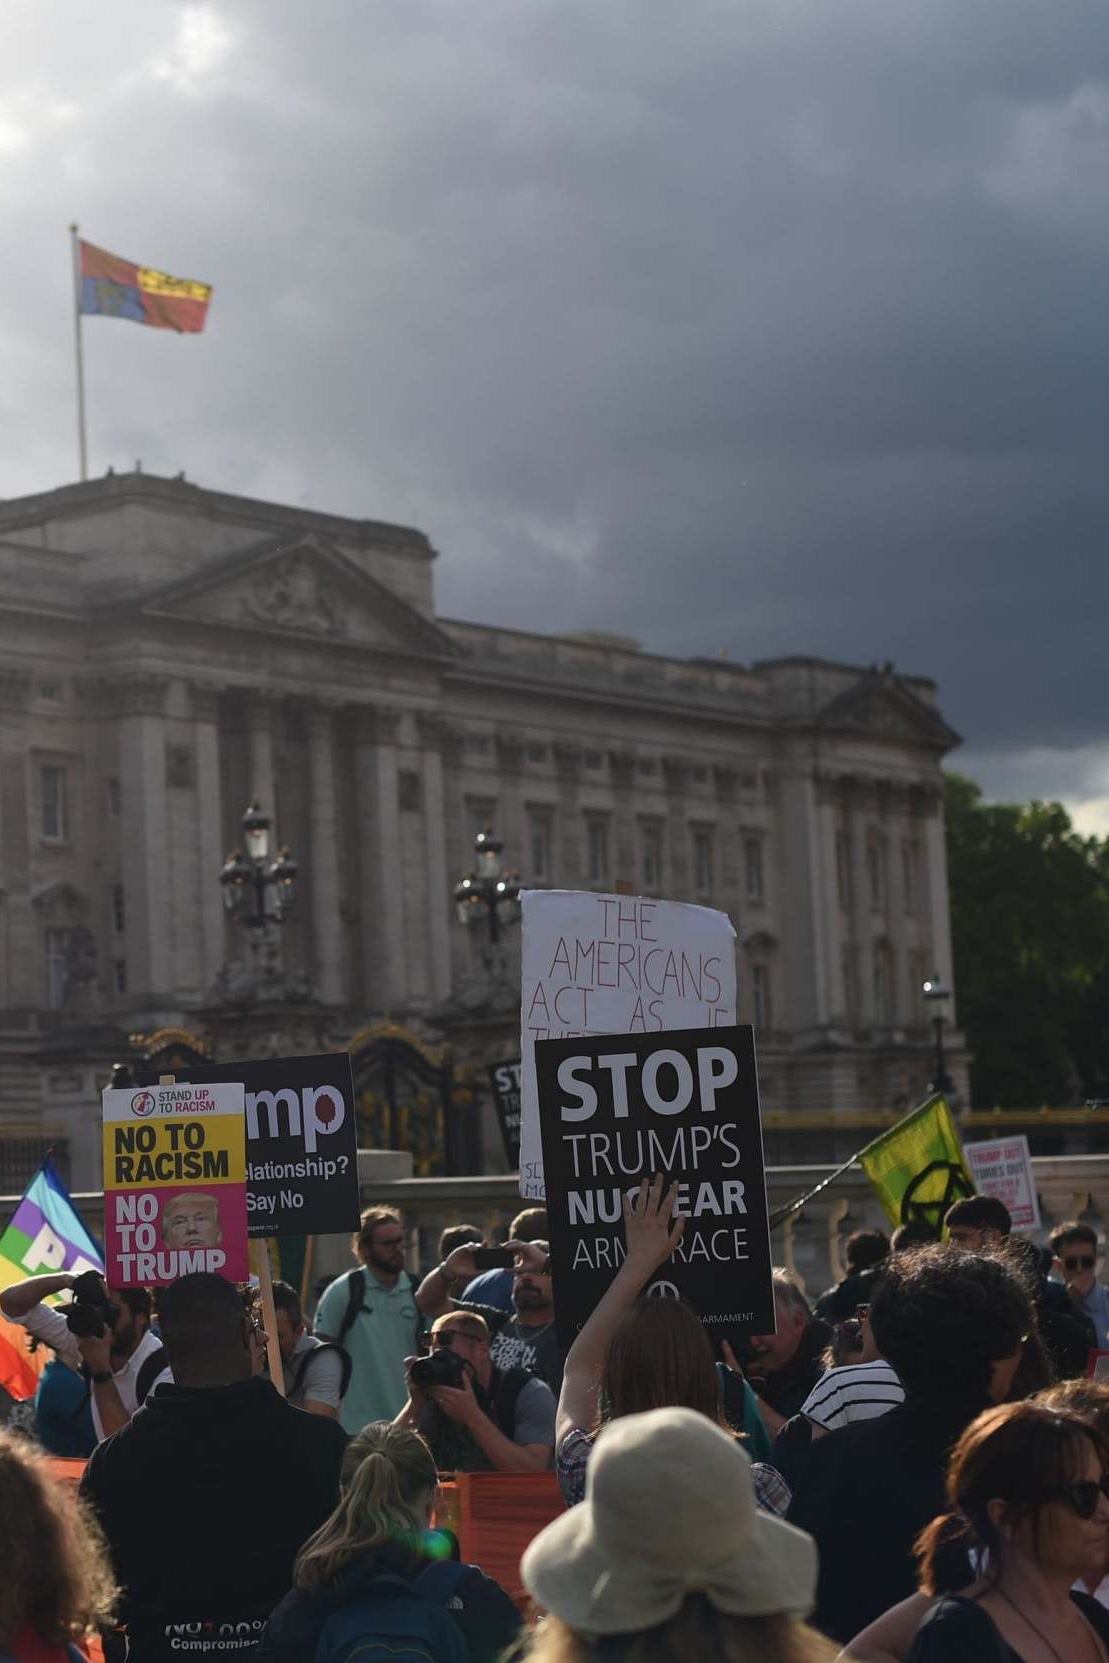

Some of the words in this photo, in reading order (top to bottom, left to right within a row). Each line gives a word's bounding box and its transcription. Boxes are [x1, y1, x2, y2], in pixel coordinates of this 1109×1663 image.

[597, 899, 658, 942] THE
[549, 937, 722, 1004] AMERICANS
[528, 982, 594, 1026] ACT
[629, 996, 664, 1032] AS
[159, 1091, 192, 1103] STAND
[194, 1090, 209, 1101] UP
[557, 1047, 739, 1122] STOP
[159, 1103, 173, 1113] TO
[175, 1100, 216, 1112] RACISM
[114, 1125, 157, 1154] NO
[164, 1122, 205, 1151] TO
[562, 1123, 741, 1178] TRUMP'S
[115, 1150, 229, 1184] RACISM
[115, 1193, 159, 1224] NO
[246, 1192, 276, 1215] Say
[280, 1190, 304, 1209] No
[567, 1180, 747, 1225] NUCEAR
[115, 1223, 157, 1253] TO
[116, 1249, 226, 1283] TRUMP
